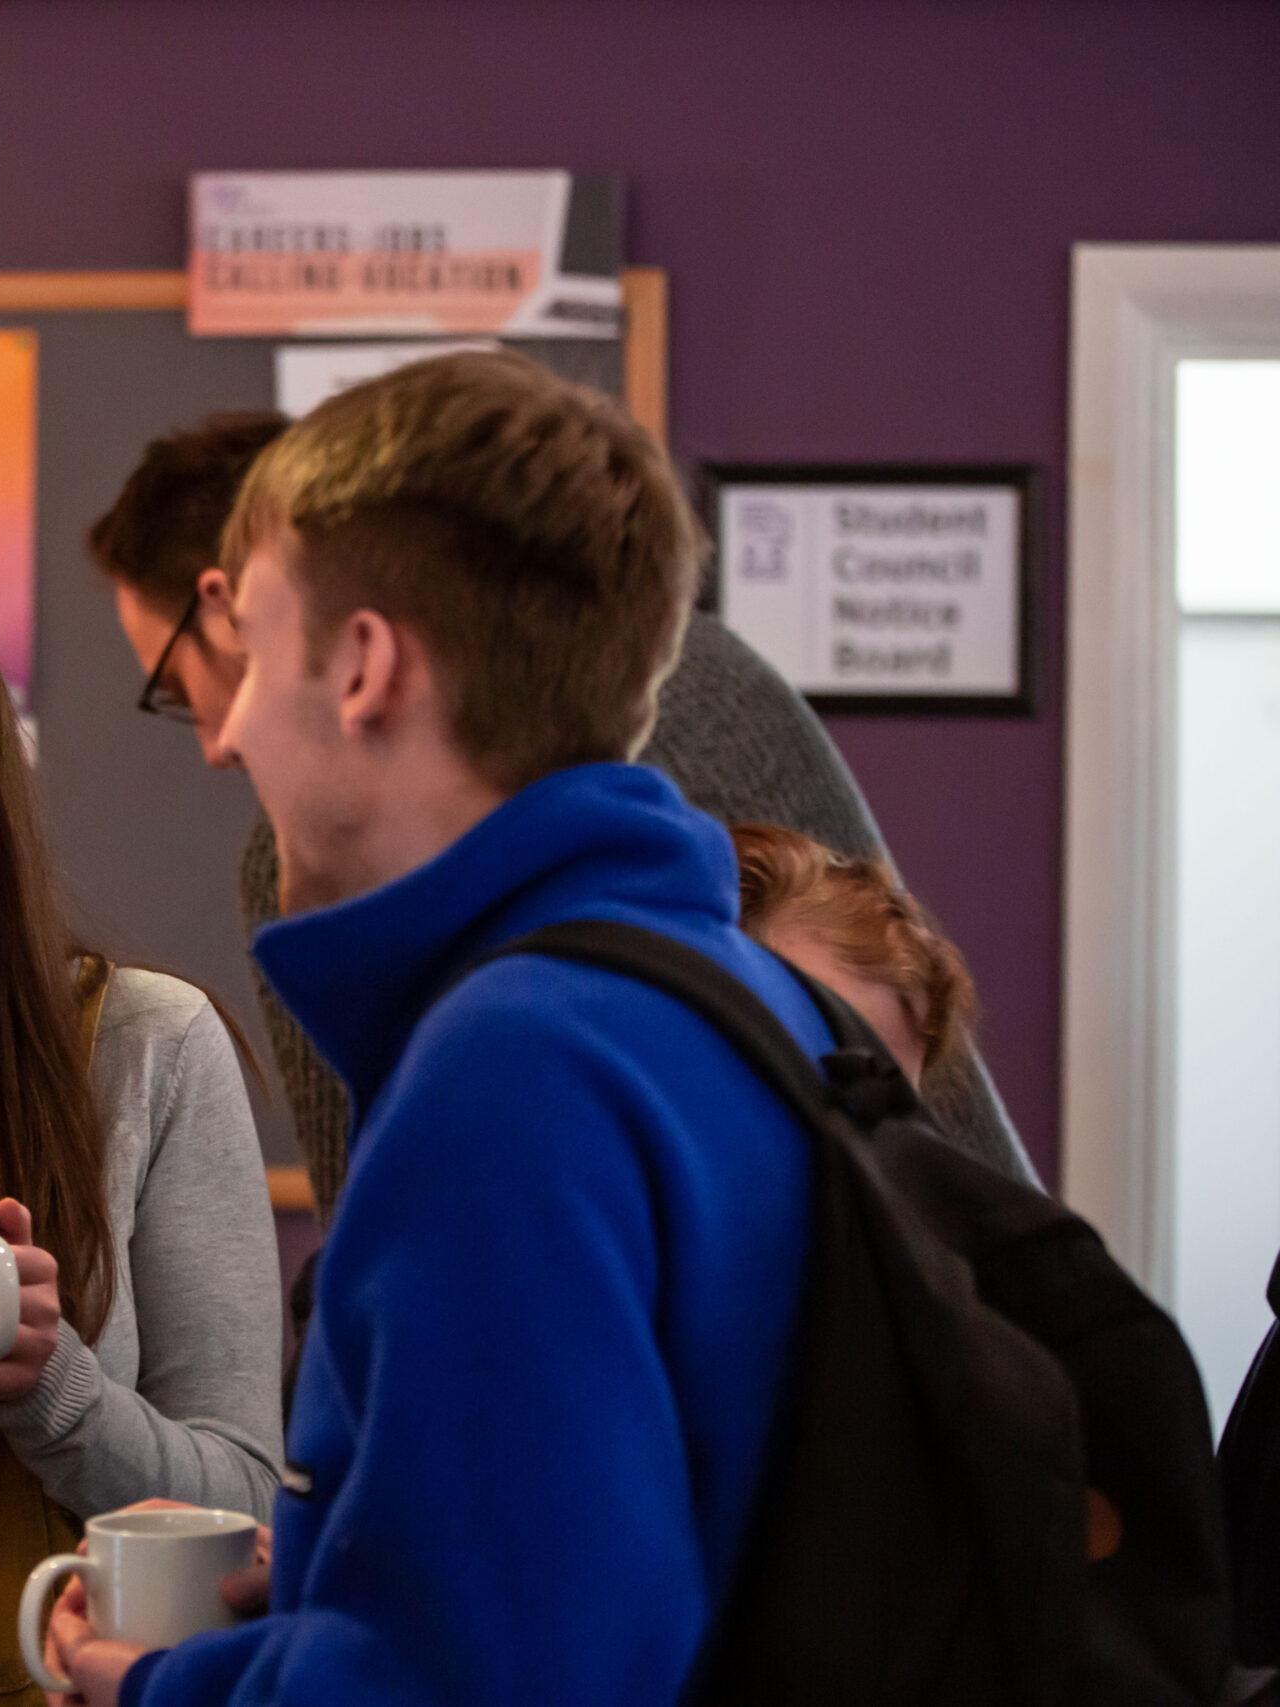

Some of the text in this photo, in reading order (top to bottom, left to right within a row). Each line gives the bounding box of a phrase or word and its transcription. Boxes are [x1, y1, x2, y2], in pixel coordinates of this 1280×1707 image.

[833, 501, 989, 537] Student
[832, 547, 982, 583] Council
[832, 594, 962, 629] Notice
[832, 639, 954, 676] Board
